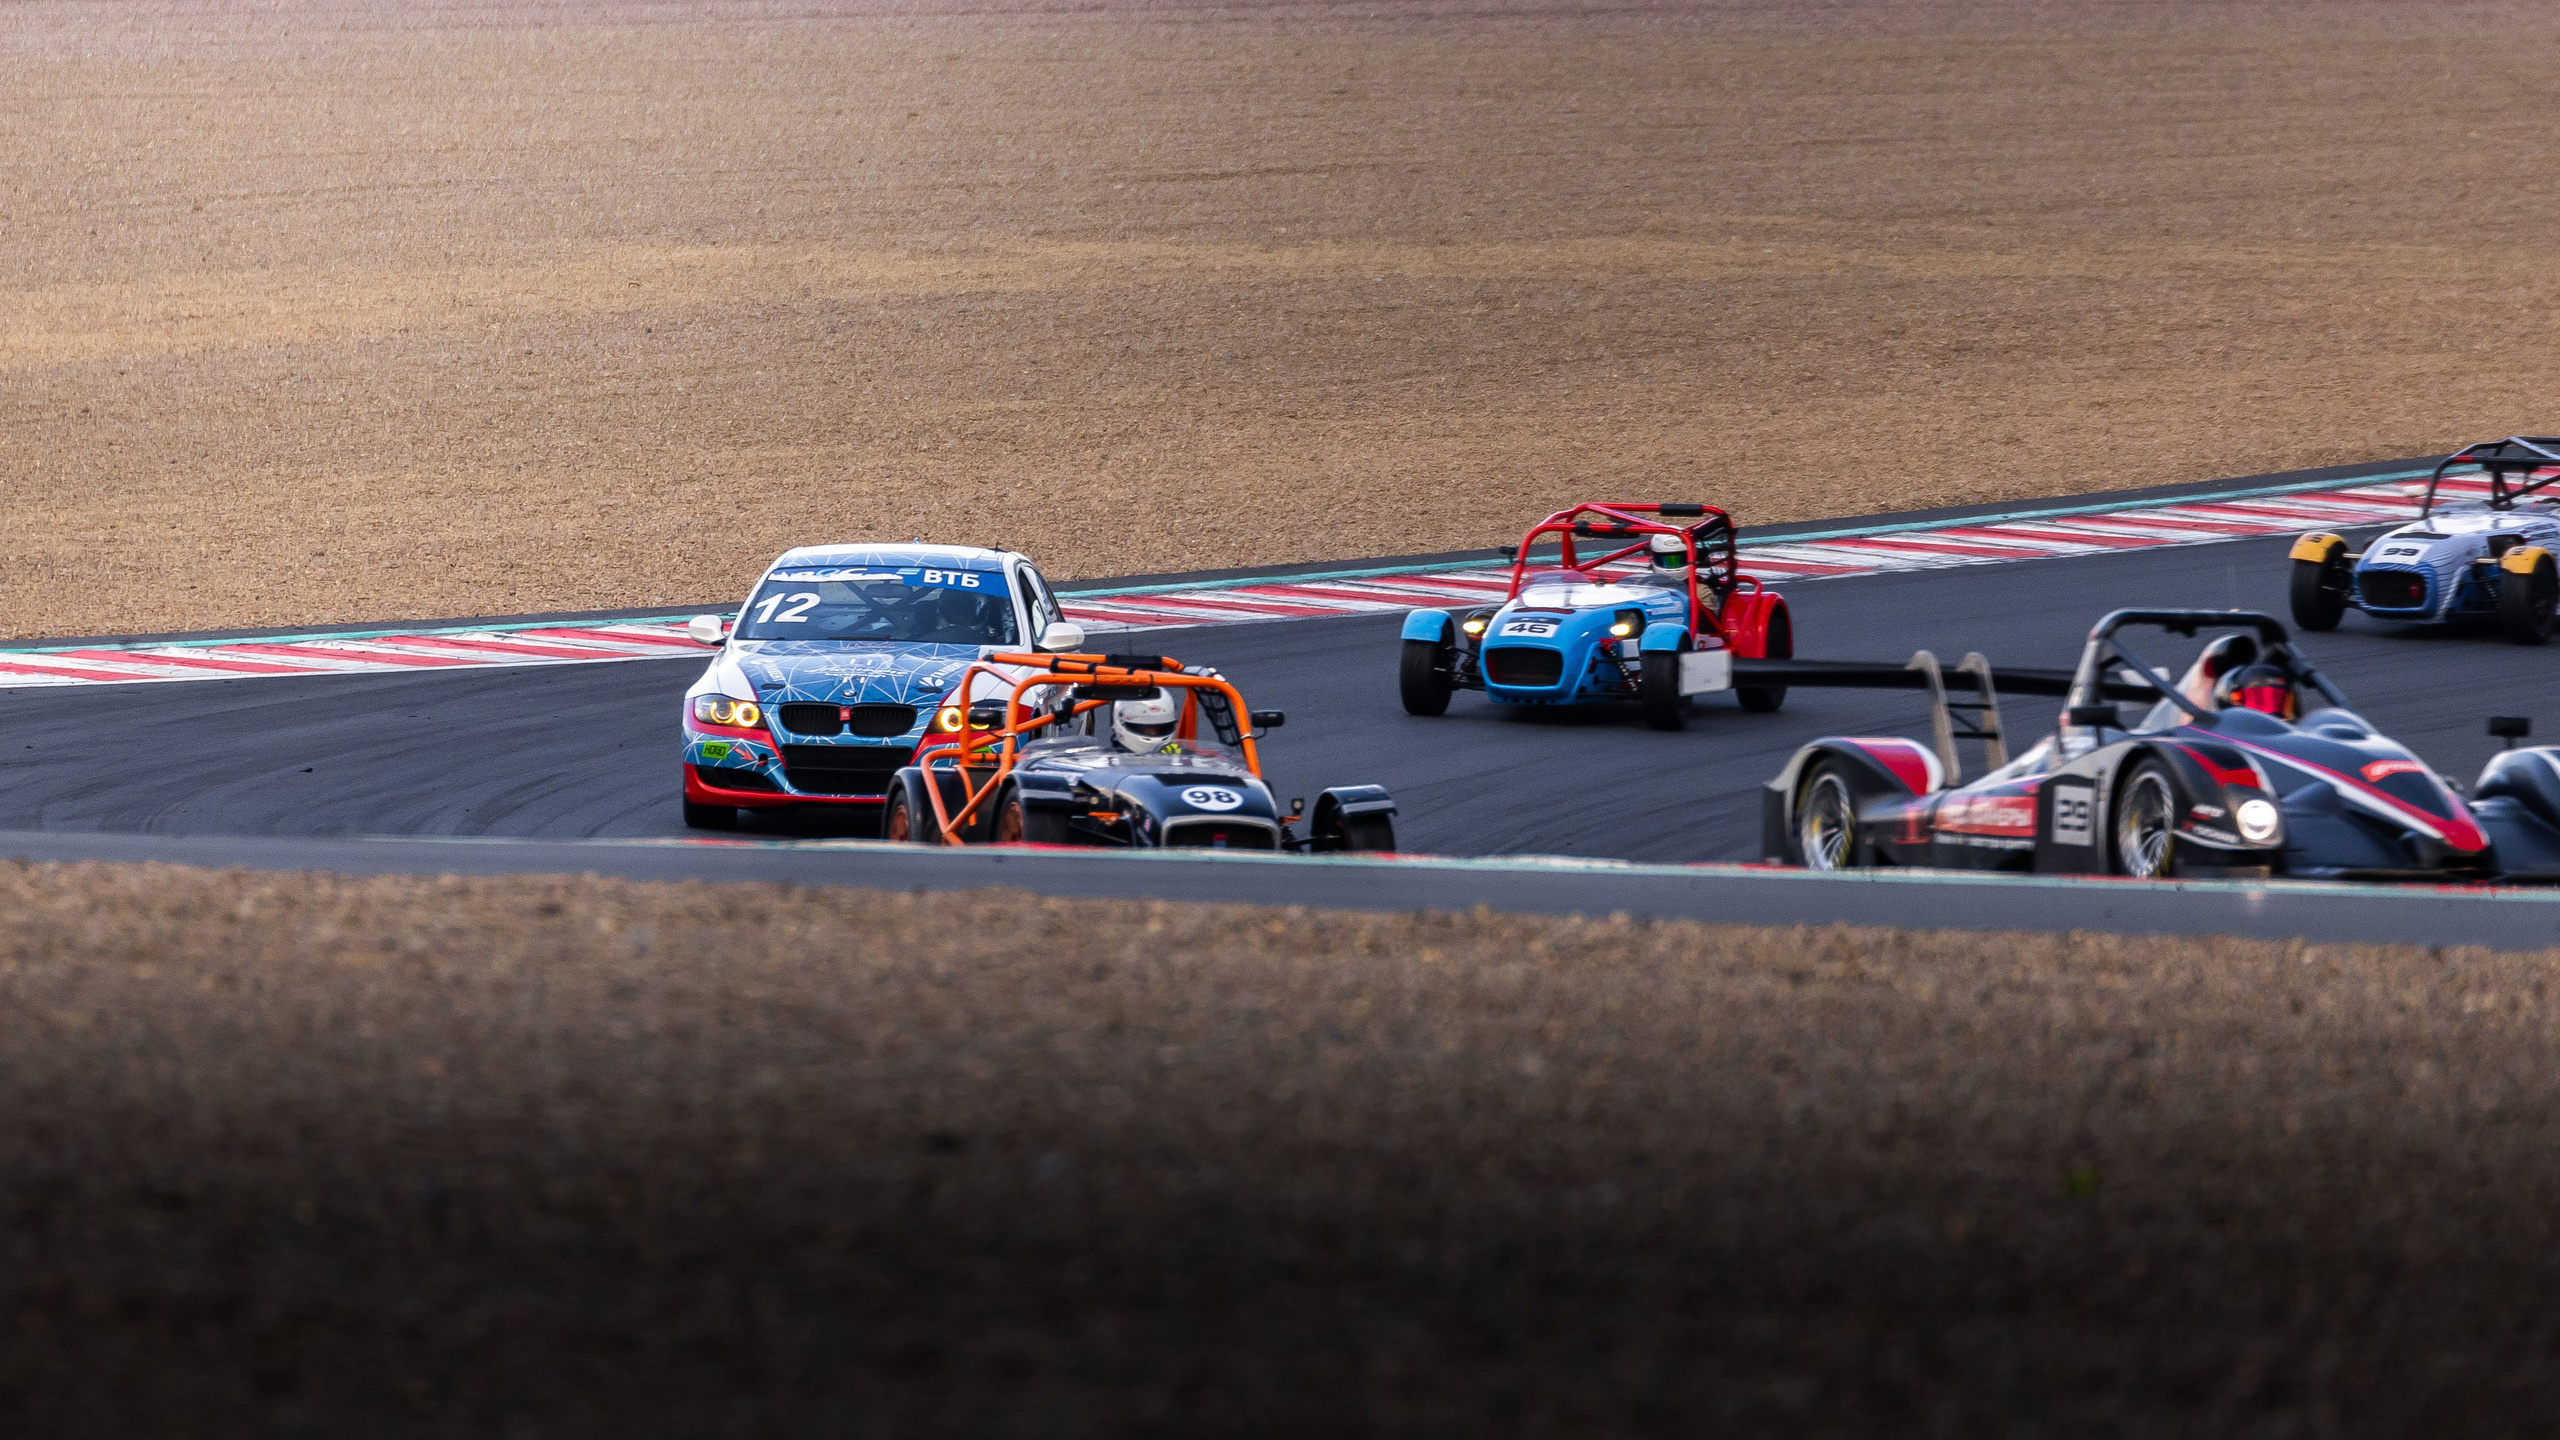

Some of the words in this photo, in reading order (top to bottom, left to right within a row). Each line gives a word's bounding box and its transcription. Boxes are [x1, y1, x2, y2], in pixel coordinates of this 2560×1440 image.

[2381, 548, 2420, 557] 99
[923, 569, 980, 588] ВТБ
[754, 592, 821, 624] 12
[1507, 623, 1549, 634] 46
[1188, 790, 1236, 804] 98
